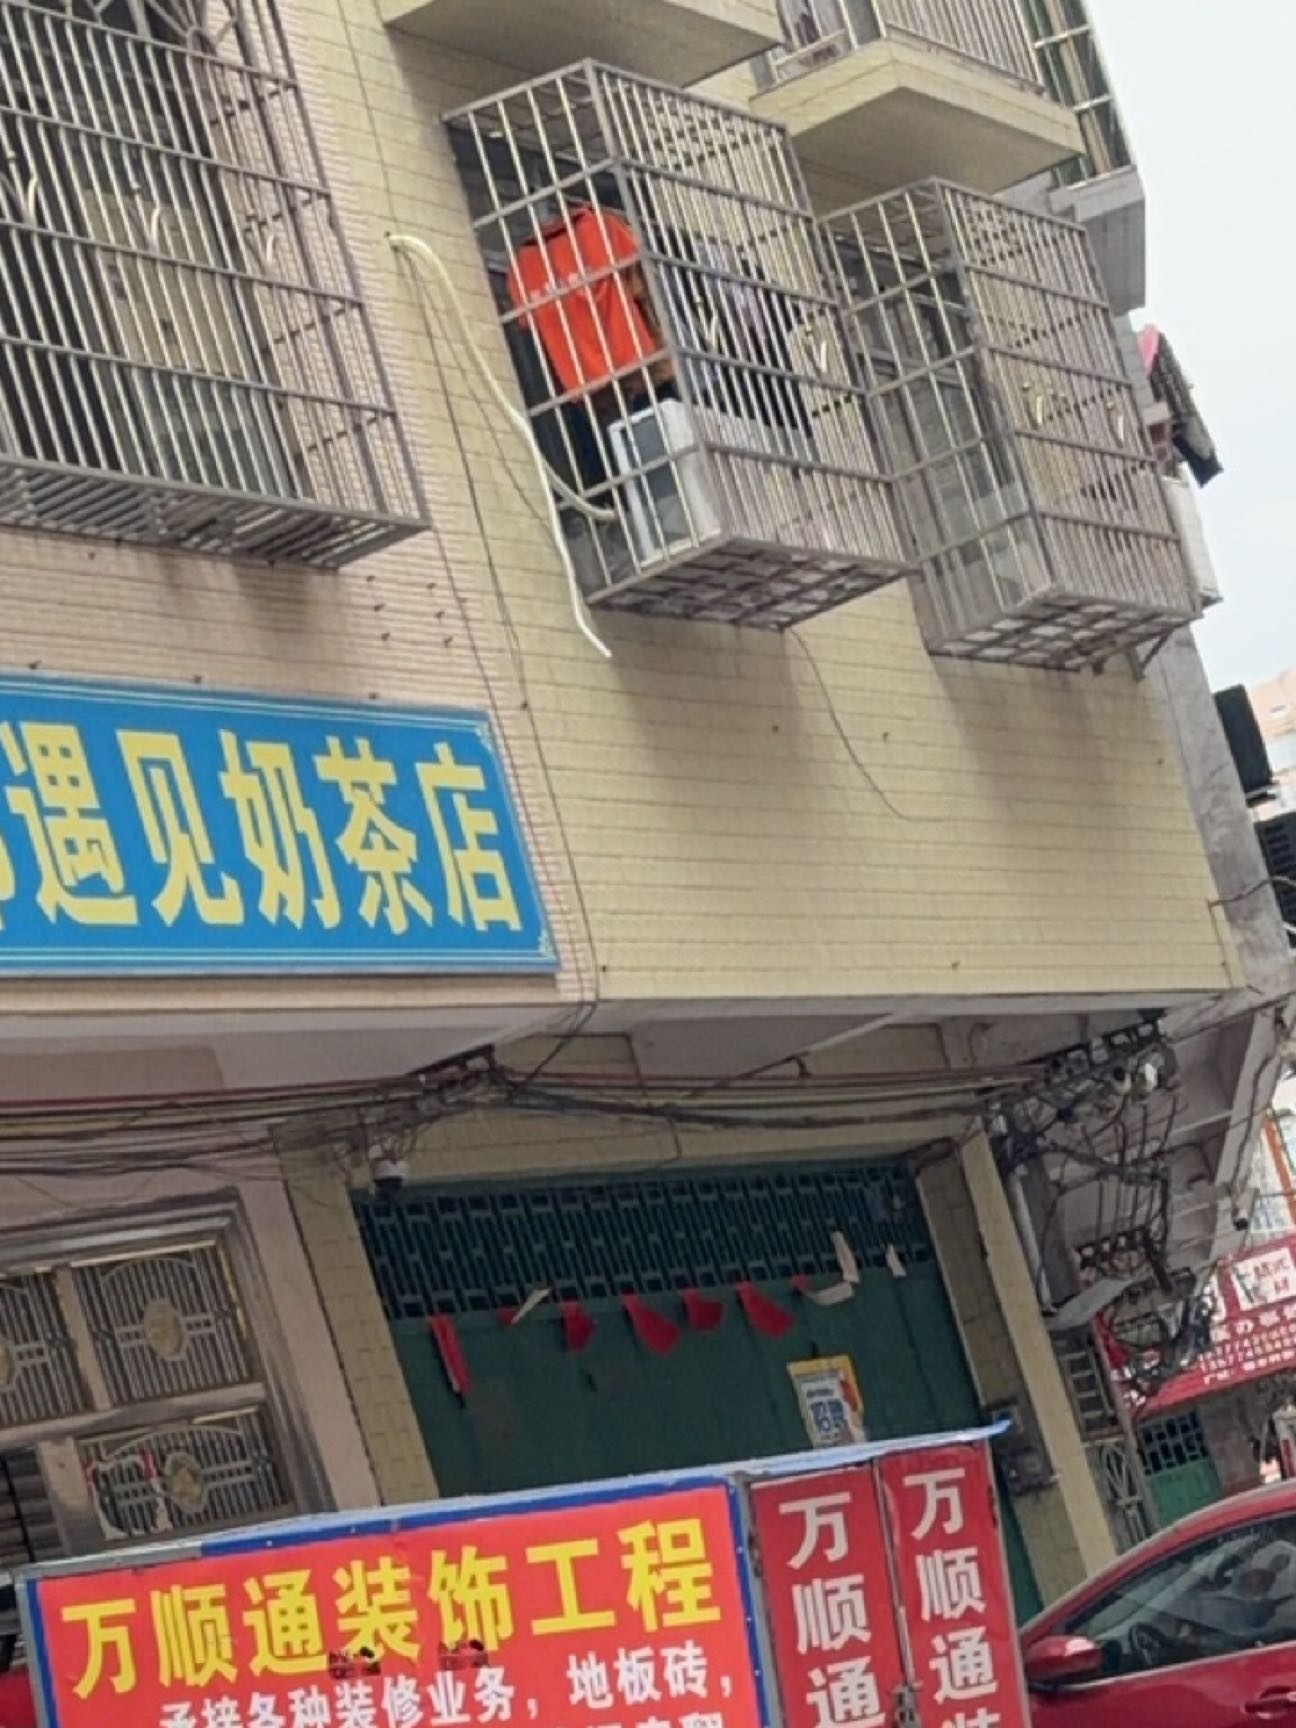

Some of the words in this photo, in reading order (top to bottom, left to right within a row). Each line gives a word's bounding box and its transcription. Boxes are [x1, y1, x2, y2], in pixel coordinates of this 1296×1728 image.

[61, 1517, 721, 1699] 万顺通装饰工程
